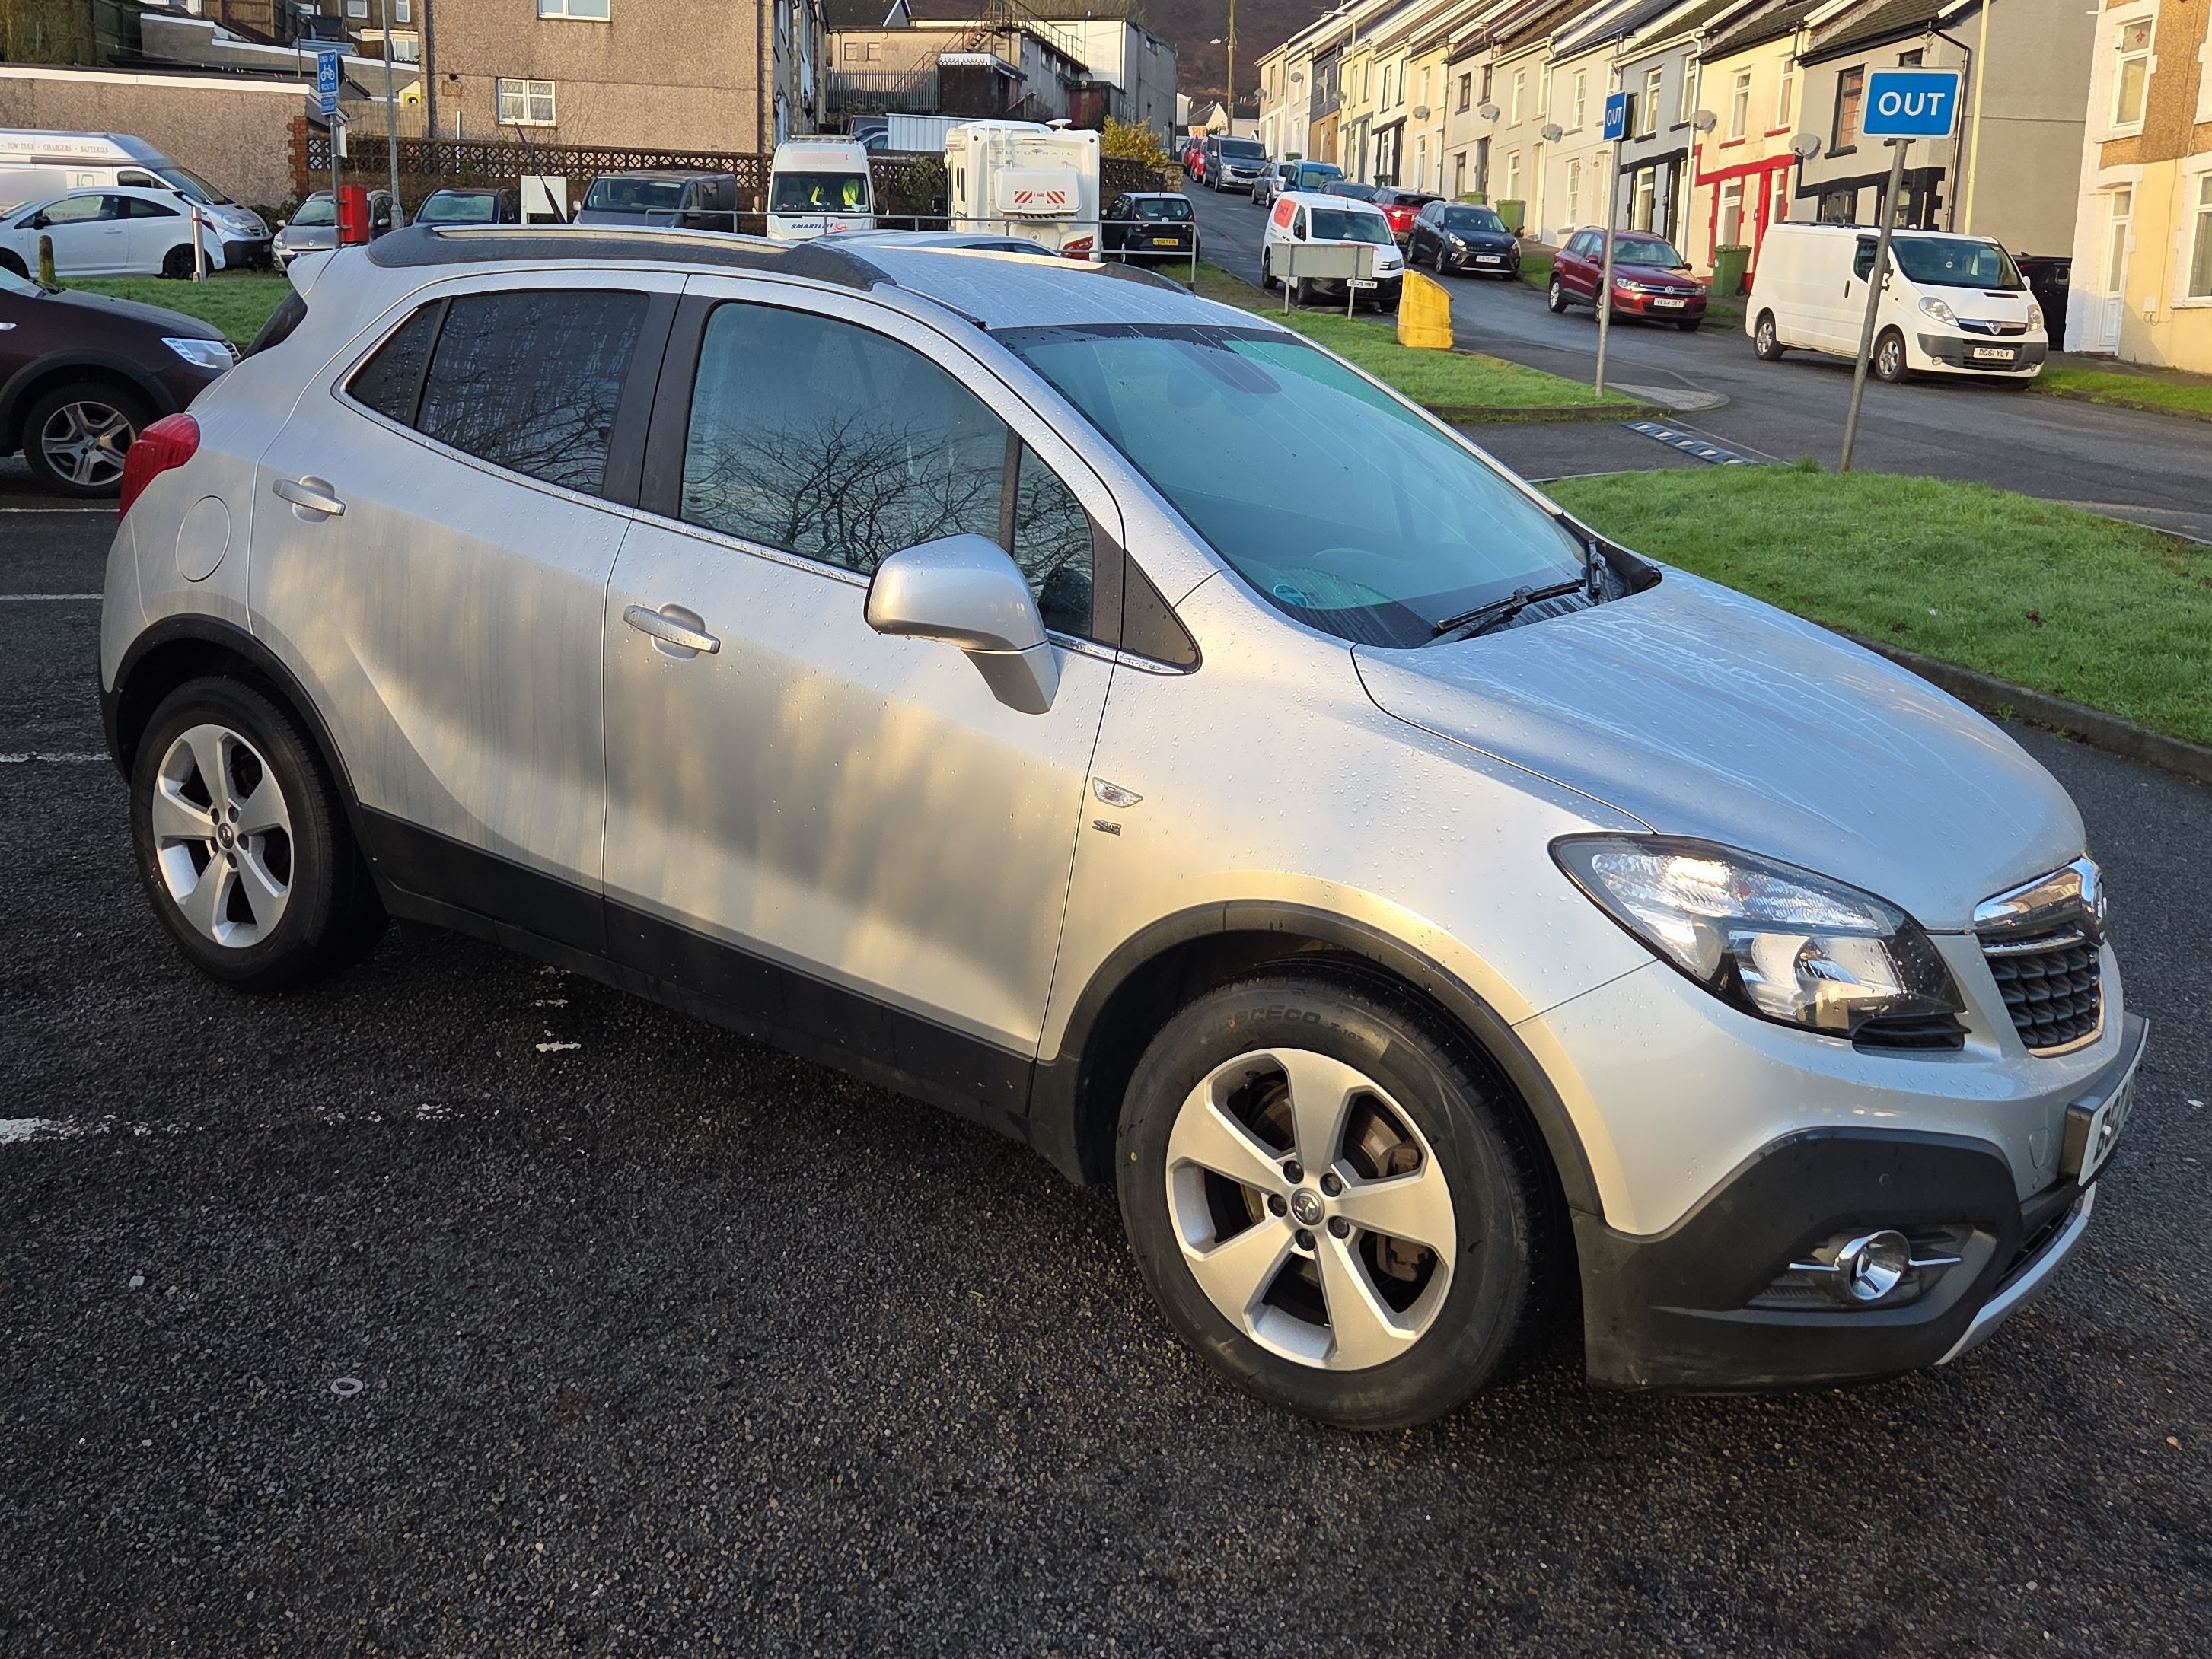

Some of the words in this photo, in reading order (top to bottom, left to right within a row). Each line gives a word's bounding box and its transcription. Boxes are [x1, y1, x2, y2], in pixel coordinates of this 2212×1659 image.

[1878, 91, 1946, 116] OUT
[1607, 106, 1623, 126] OUT
[43, 143, 72, 152] CHARGERS
